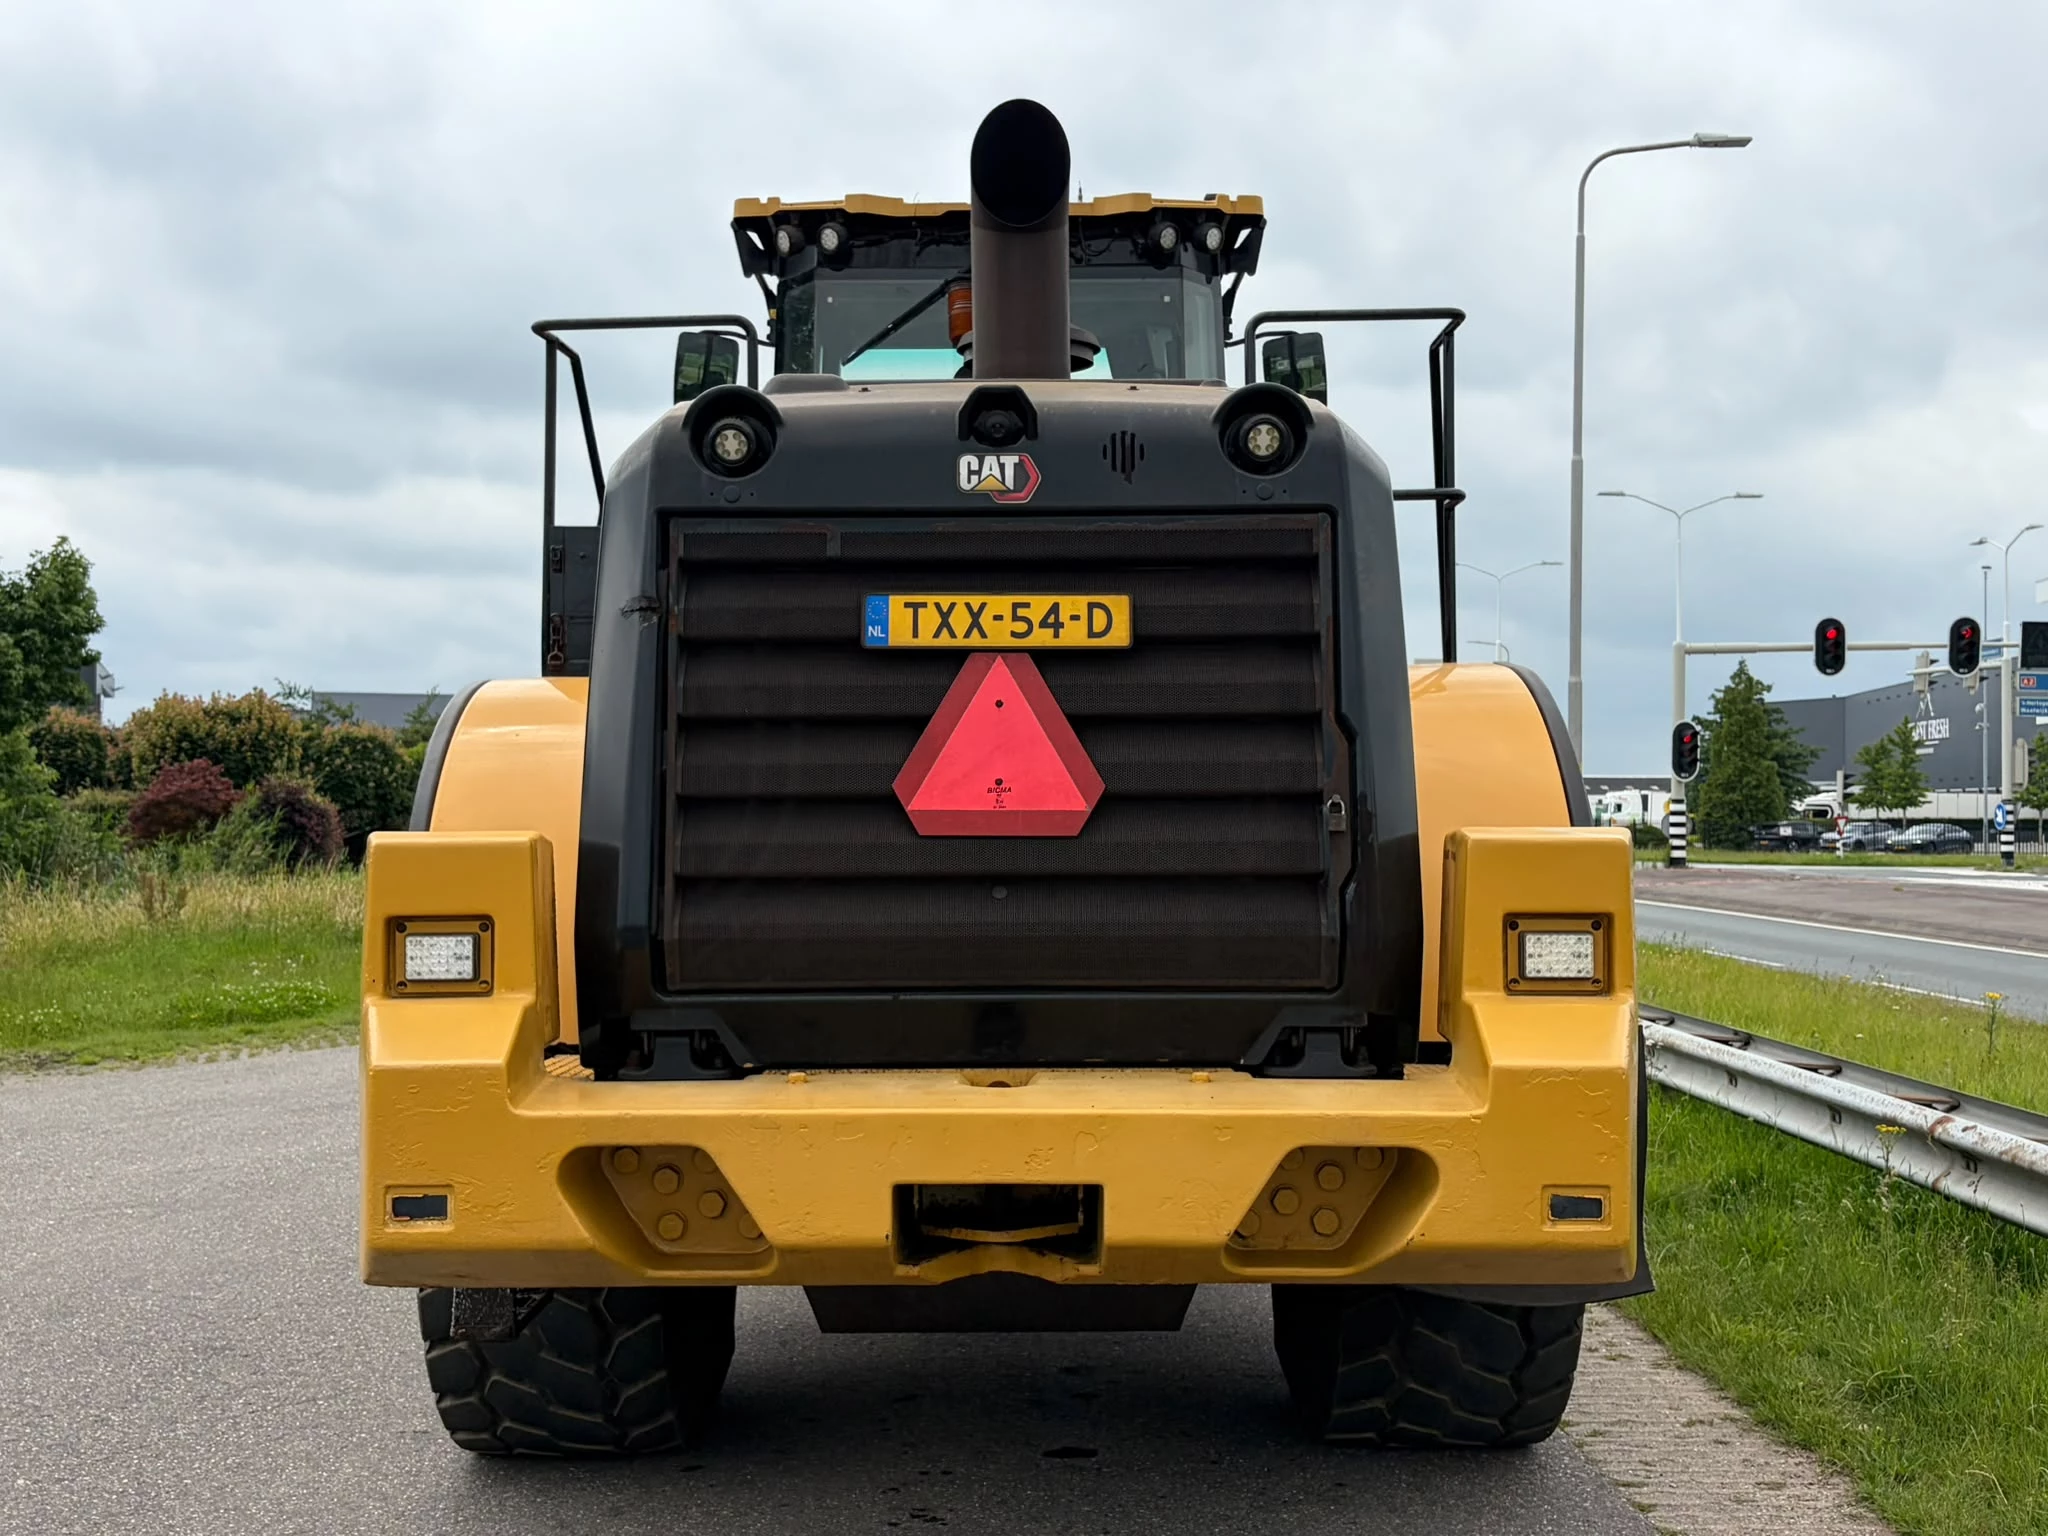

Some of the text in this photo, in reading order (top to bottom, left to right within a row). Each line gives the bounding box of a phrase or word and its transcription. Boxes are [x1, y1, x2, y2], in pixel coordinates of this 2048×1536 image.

[959, 455, 1020, 491] CAT
[868, 625, 886, 637] NL
[903, 601, 1114, 639] TXX-54-D
[1928, 717, 1950, 740] FRESH
